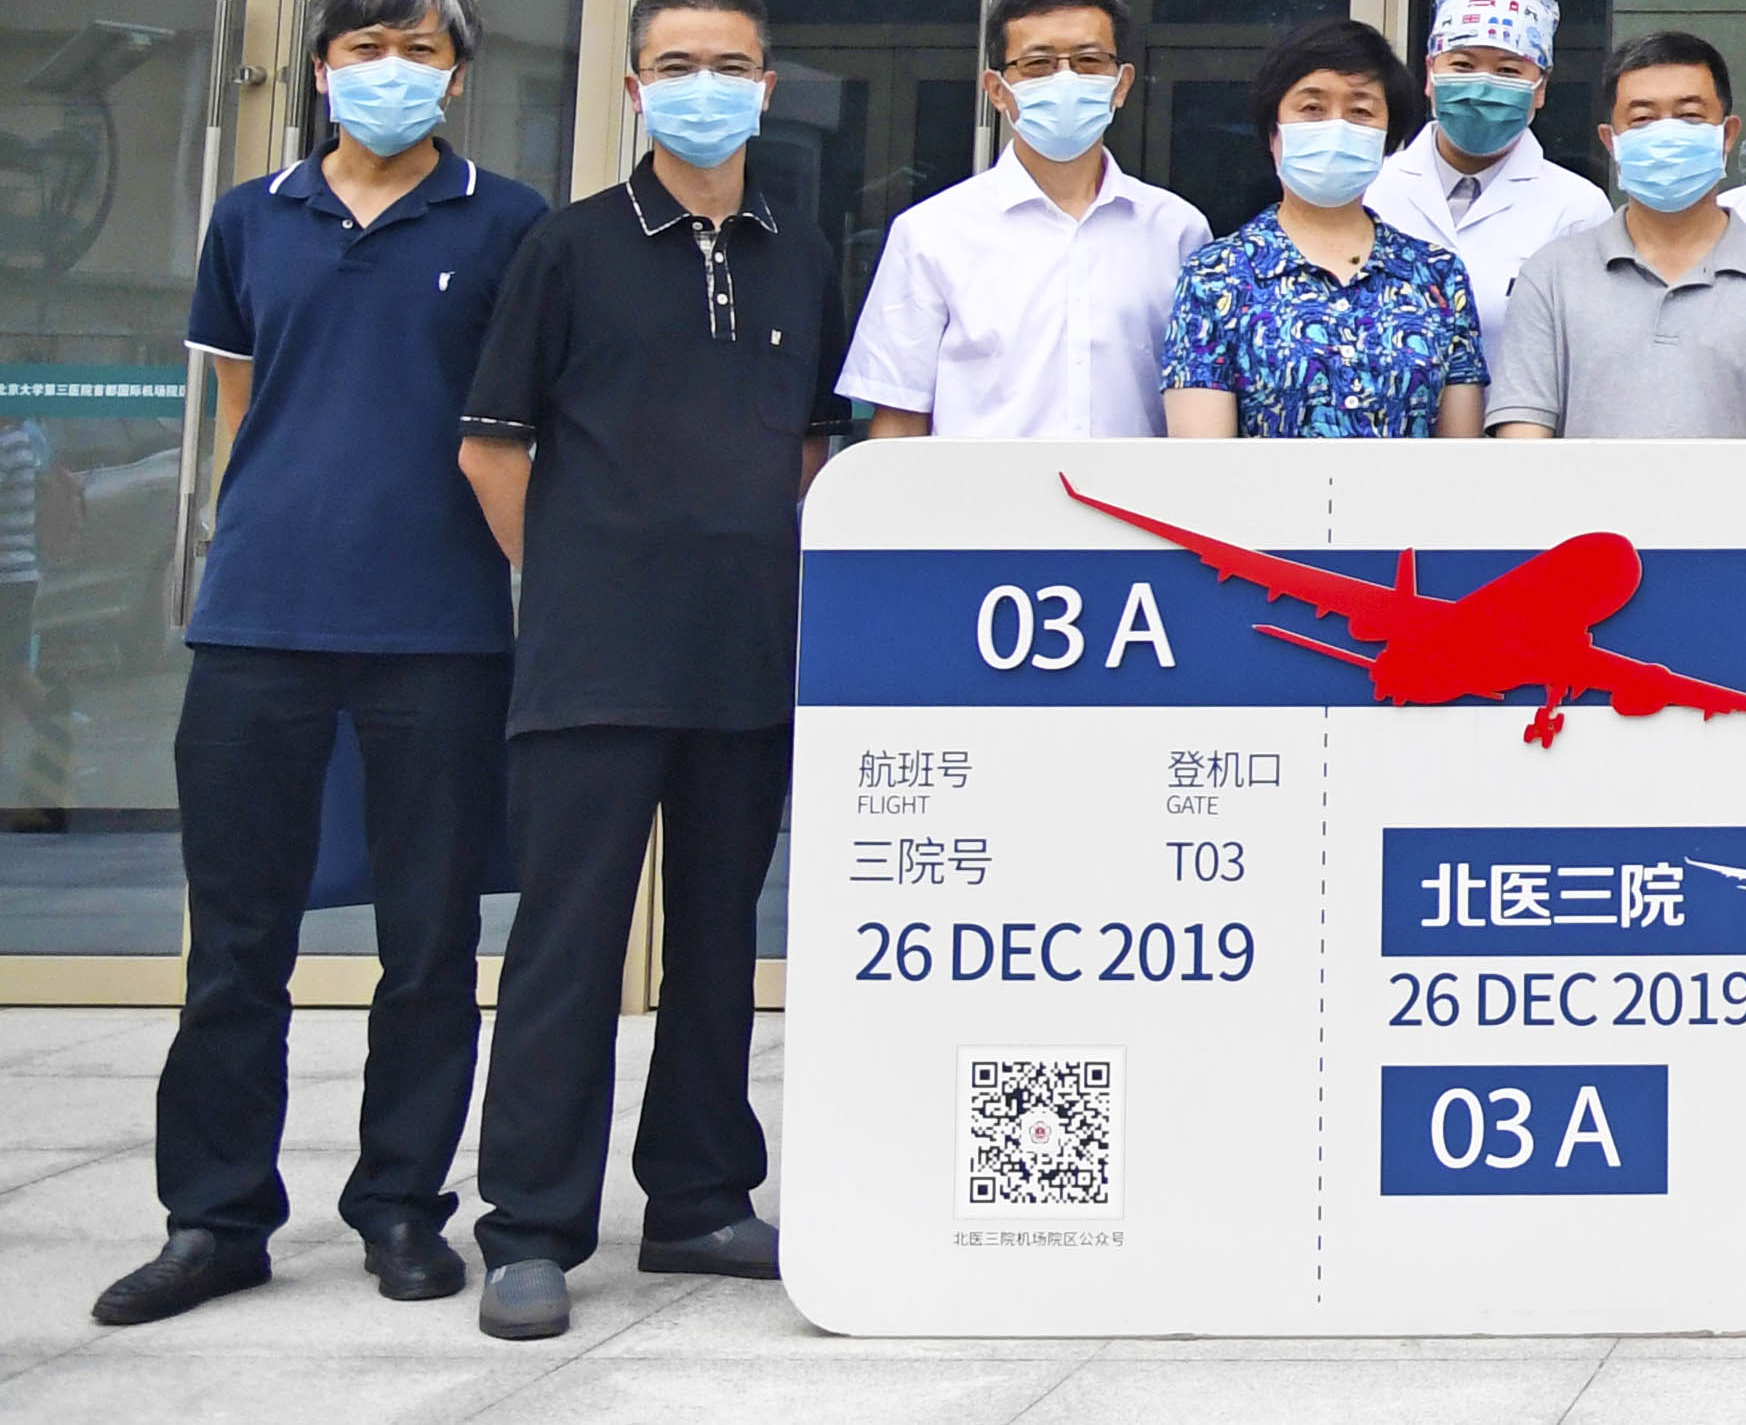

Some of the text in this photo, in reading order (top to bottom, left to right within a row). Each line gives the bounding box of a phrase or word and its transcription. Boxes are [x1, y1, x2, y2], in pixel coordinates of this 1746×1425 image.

[977, 583, 1175, 670] 03 A
[859, 750, 972, 788] 航班号
[1168, 750, 1280, 788] 登机口
[858, 796, 930, 814] FLIGHT
[1167, 795, 1218, 815] GATE
[850, 837, 992, 885] 三院号
[1166, 842, 1244, 881] T03
[1421, 862, 1685, 928] 北医三院
[856, 922, 1254, 981] 26 DEC 2019
[1389, 973, 1459, 1026] 26
[1478, 973, 1597, 1026] DEC
[1431, 1086, 1621, 1168] 03 A
[953, 1230, 1124, 1247] 北医三院机场院区公众号
